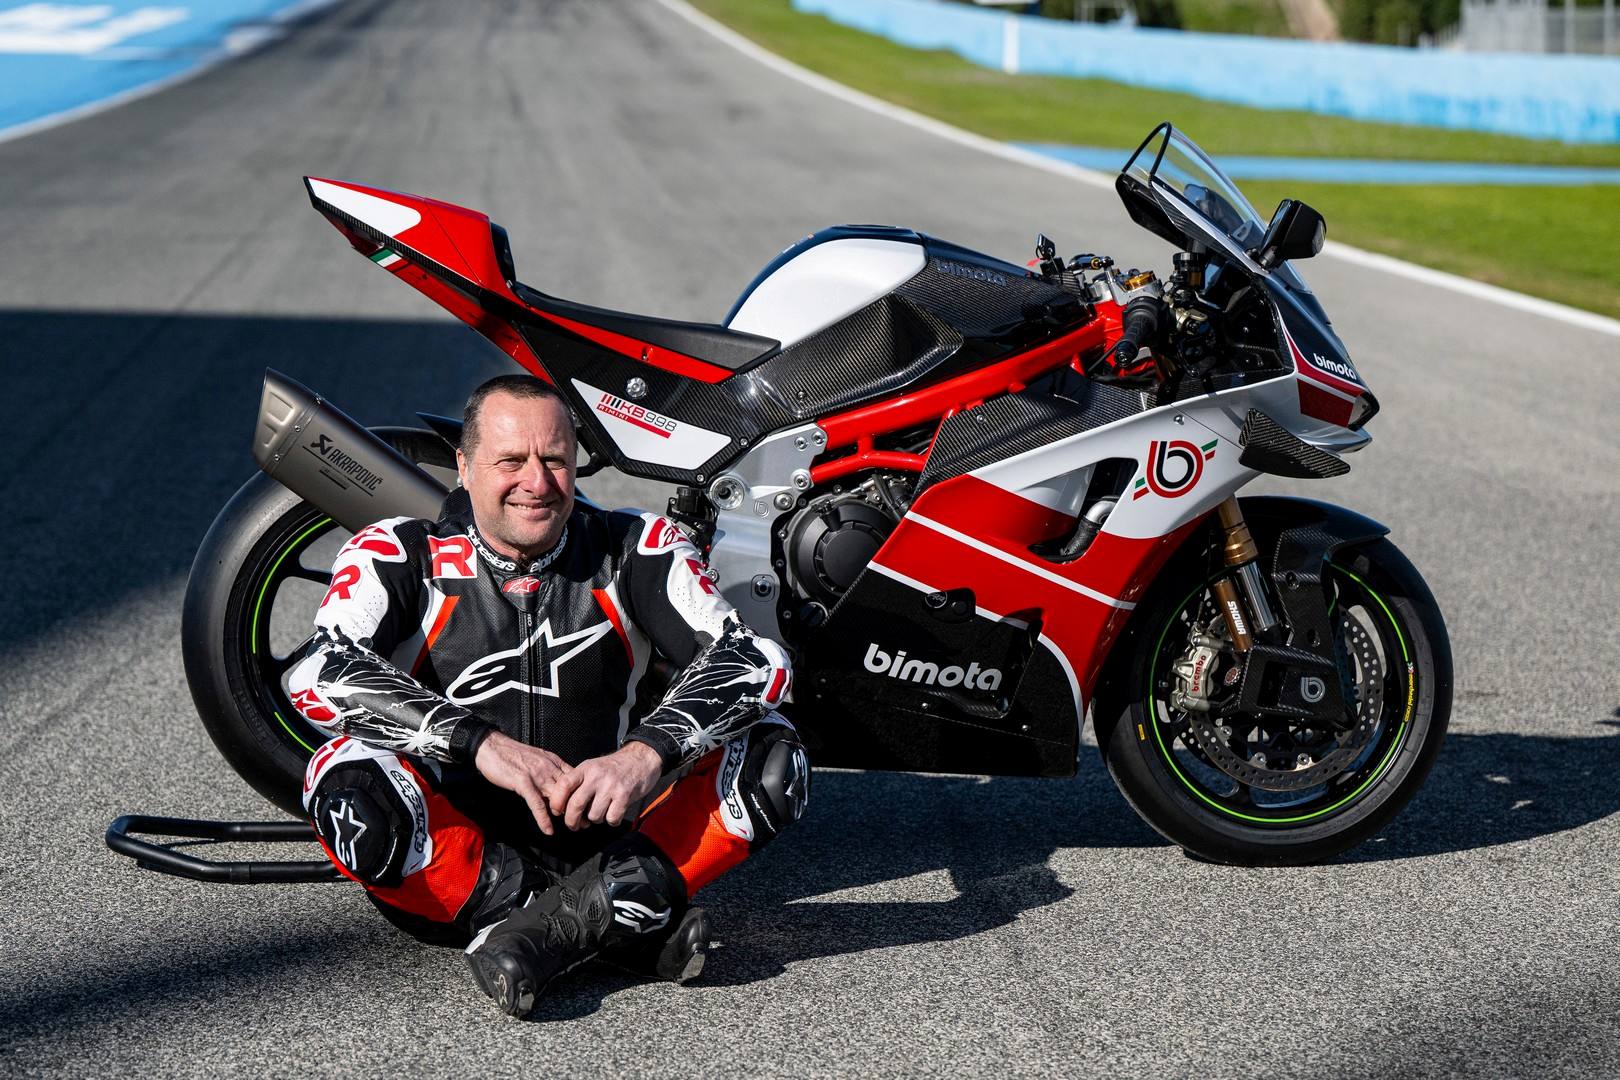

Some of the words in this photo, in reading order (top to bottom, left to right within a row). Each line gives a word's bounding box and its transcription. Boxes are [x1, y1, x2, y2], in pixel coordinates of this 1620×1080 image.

[1313, 352, 1357, 380] bimota
[427, 534, 477, 577] R
[320, 564, 361, 609] R
[1227, 600, 1247, 635] SHOWA
[863, 642, 1003, 691] bimota
[1191, 654, 1207, 693] brembo
